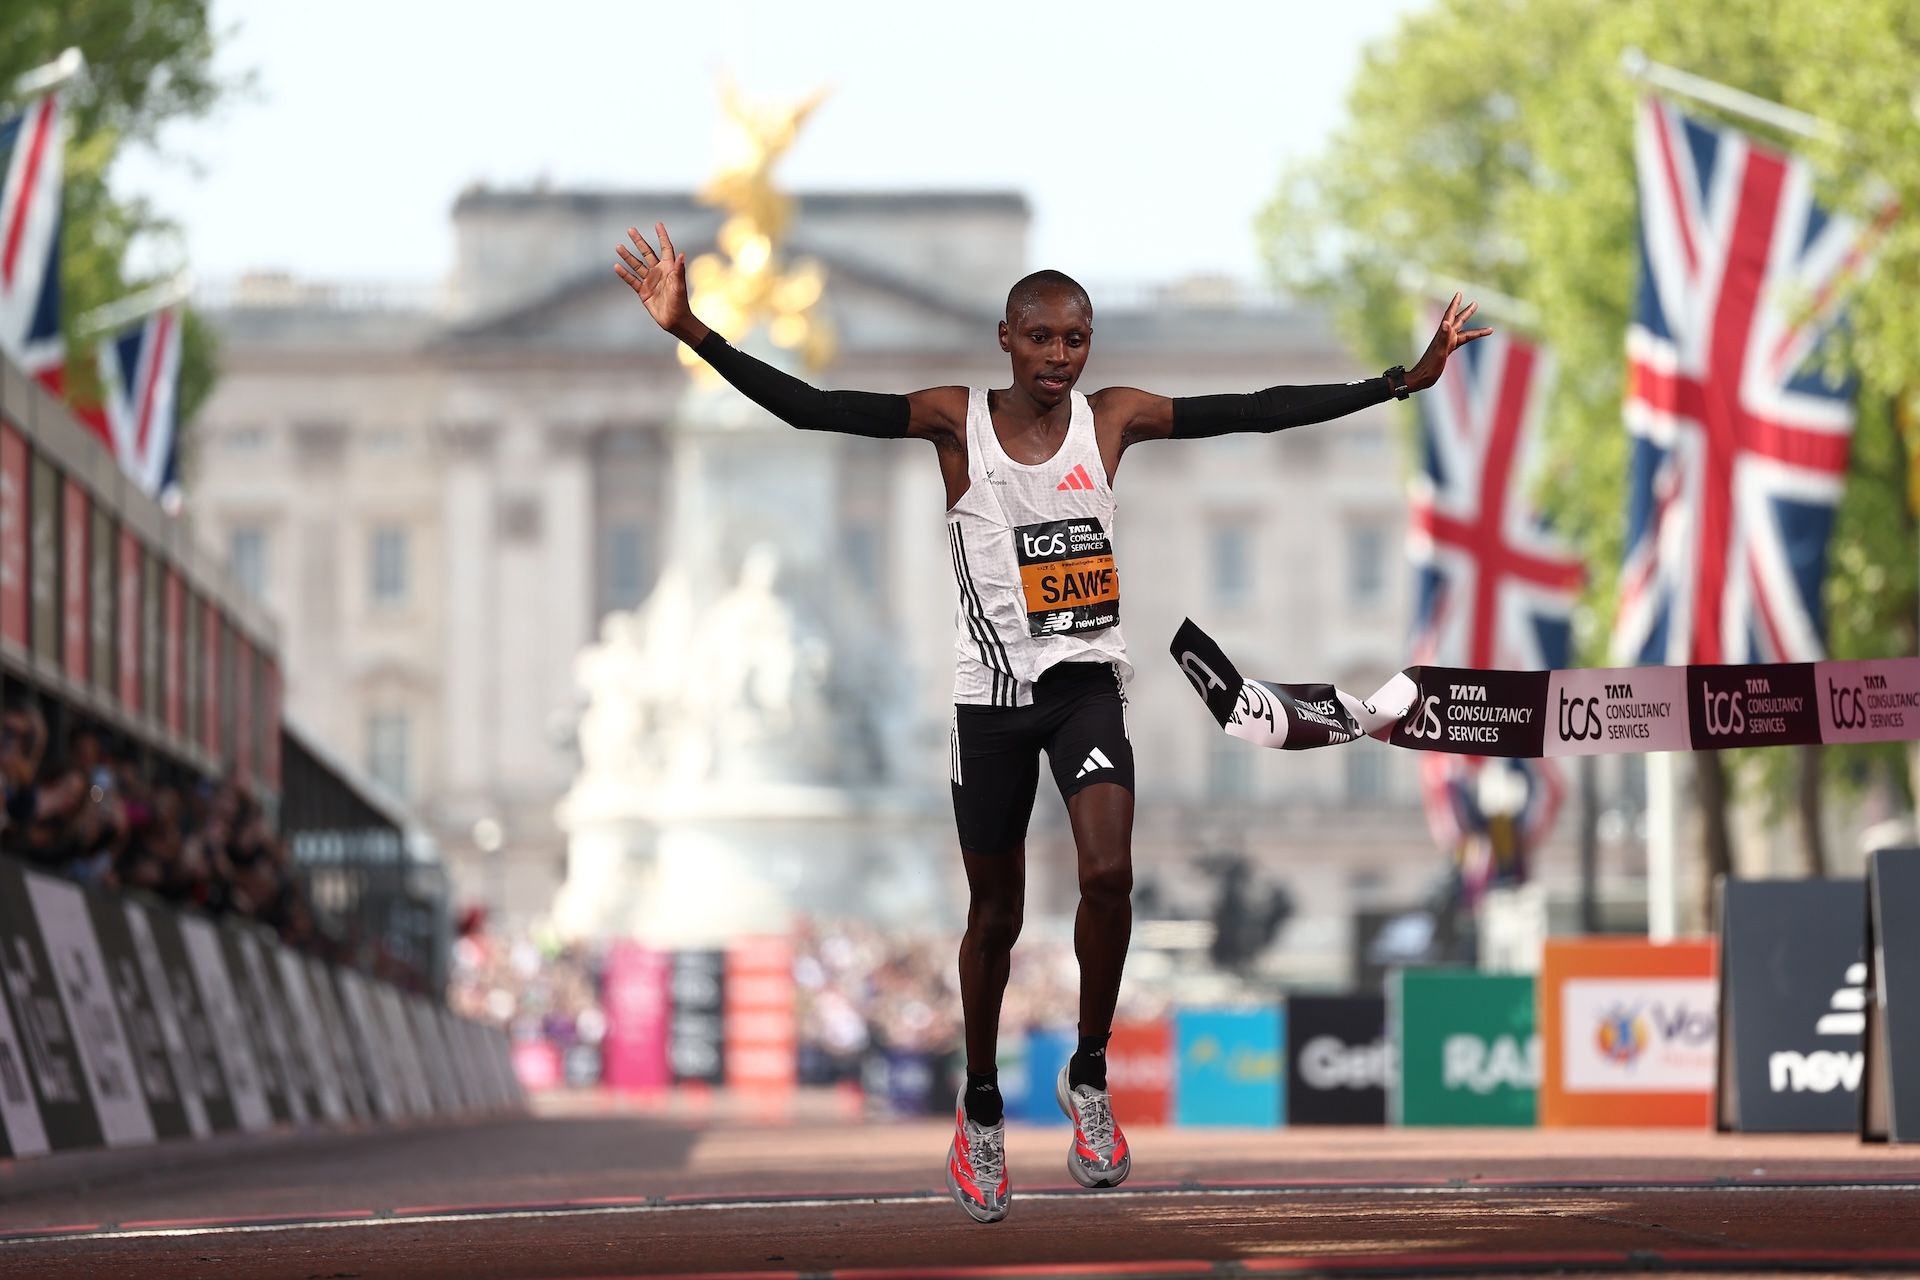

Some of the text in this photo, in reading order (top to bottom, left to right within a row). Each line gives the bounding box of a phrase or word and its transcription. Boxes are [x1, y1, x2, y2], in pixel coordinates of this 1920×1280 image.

[1068, 525, 1092, 534] TATA
[1023, 532, 1066, 558] tcs
[1071, 542, 1104, 552] SERVICES
[1041, 568, 1113, 604] SAWE
[1075, 617, 1095, 629] new
[1746, 679, 1770, 694] TATA
[1864, 675, 1887, 689] TATA
[1449, 684, 1487, 702] TATA
[1605, 684, 1633, 699] TATA
[1704, 681, 1745, 735] tcs
[1747, 697, 1804, 714] CONSULTANCY
[1828, 677, 1866, 729] tcs
[1867, 692, 1920, 709] CONSULTANC
[1447, 704, 1533, 723] CONSULTANCY
[1559, 687, 1602, 741] tcs
[1606, 702, 1671, 719] CONSULTANCY
[1749, 717, 1786, 733] SERVICES
[1869, 712, 1905, 728] SERVICES
[1447, 725, 1500, 742] SERVICES
[1608, 724, 1650, 739] SERVICES
